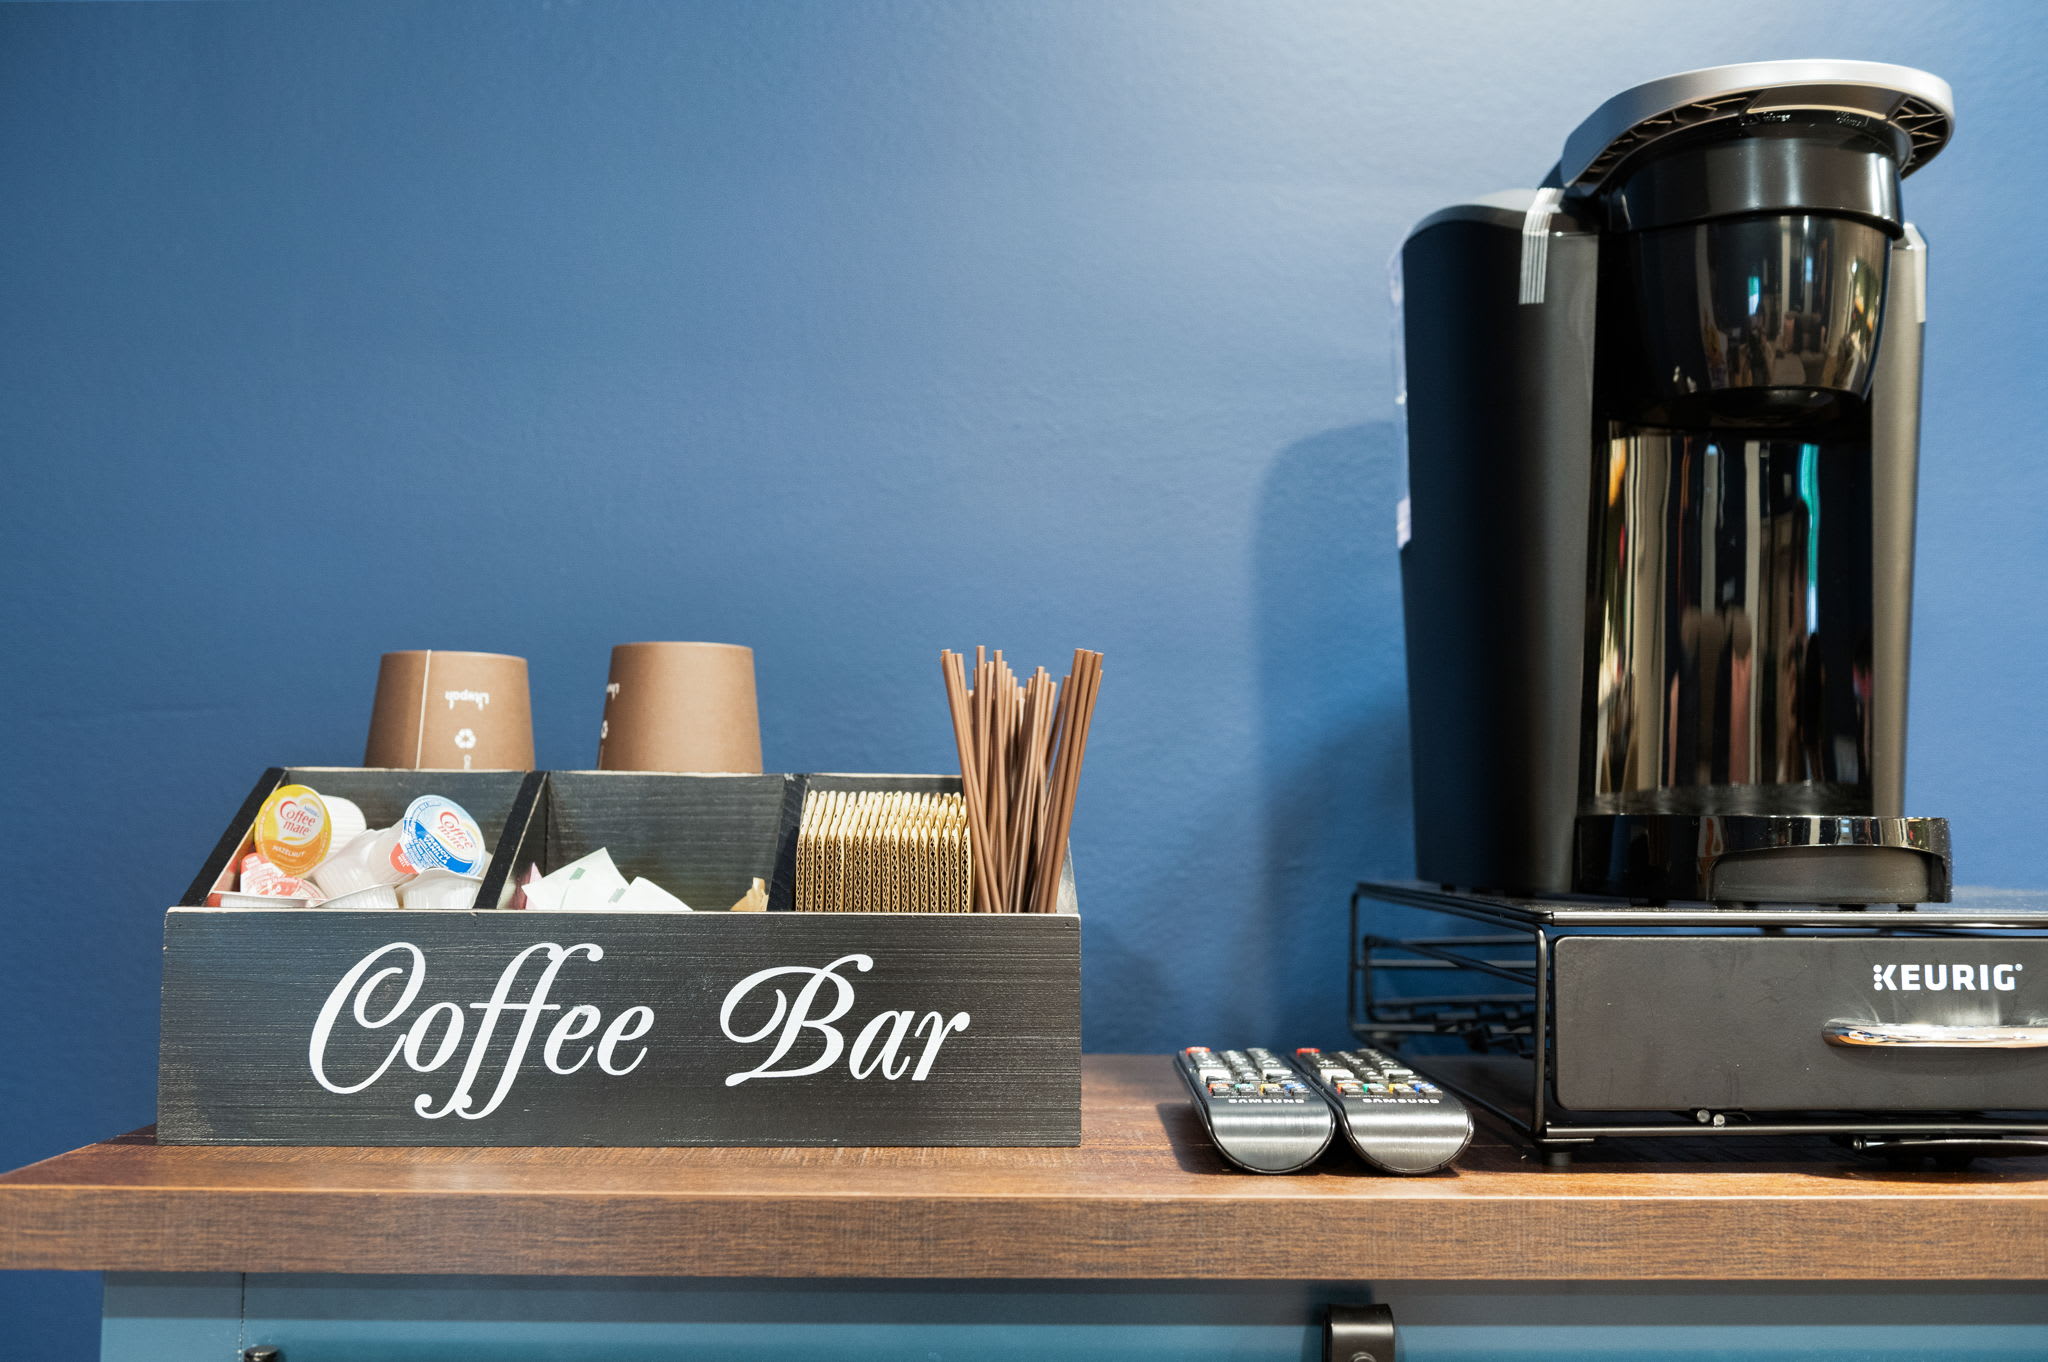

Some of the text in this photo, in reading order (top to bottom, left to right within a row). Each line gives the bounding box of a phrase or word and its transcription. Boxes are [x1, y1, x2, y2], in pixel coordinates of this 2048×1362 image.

[280, 800, 316, 827] Coffee
[283, 821, 311, 836] mate
[1873, 963, 2016, 991] KEURIG
[309, 942, 970, 1120] Coffee Bar
